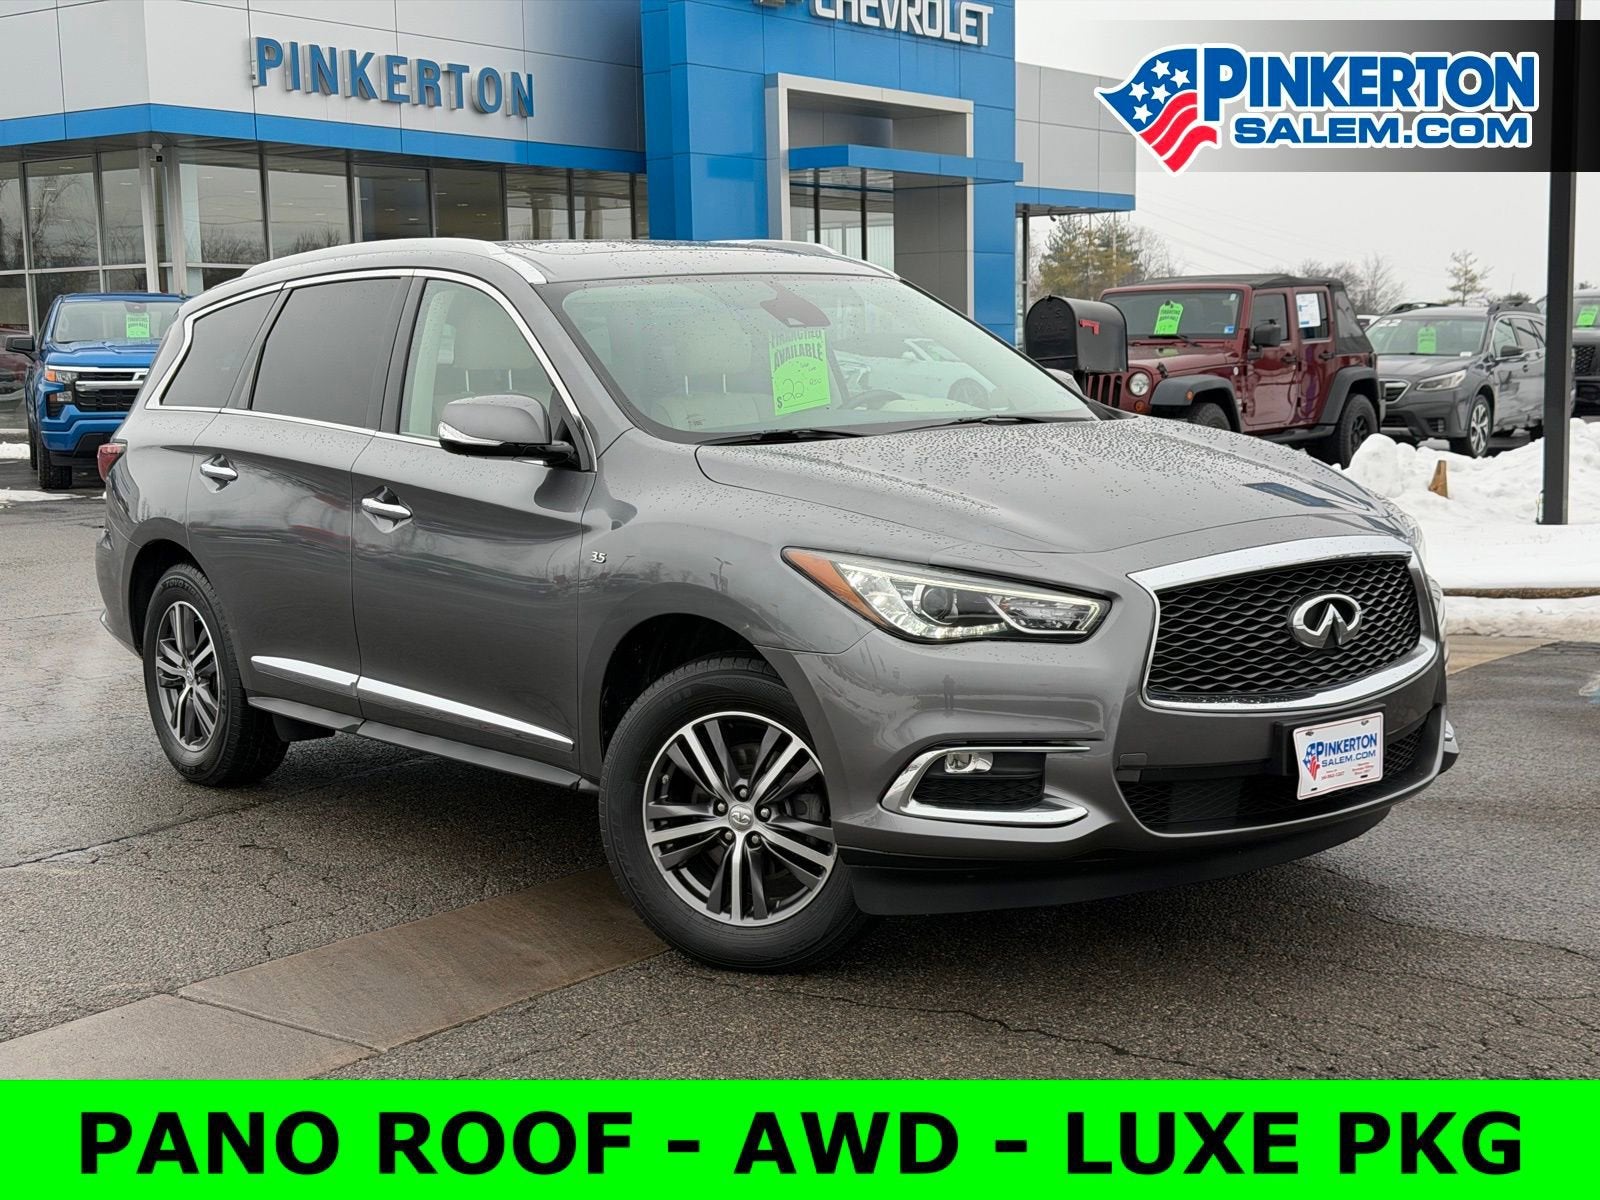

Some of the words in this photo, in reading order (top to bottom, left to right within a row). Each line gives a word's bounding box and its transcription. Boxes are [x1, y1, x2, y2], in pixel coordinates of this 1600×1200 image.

[251, 36, 535, 118] PINKERTON
[772, 342, 824, 373] AVAILABLE
[1316, 733, 1378, 762] PINKERTON
[1321, 750, 1377, 768] SALEM.COM
